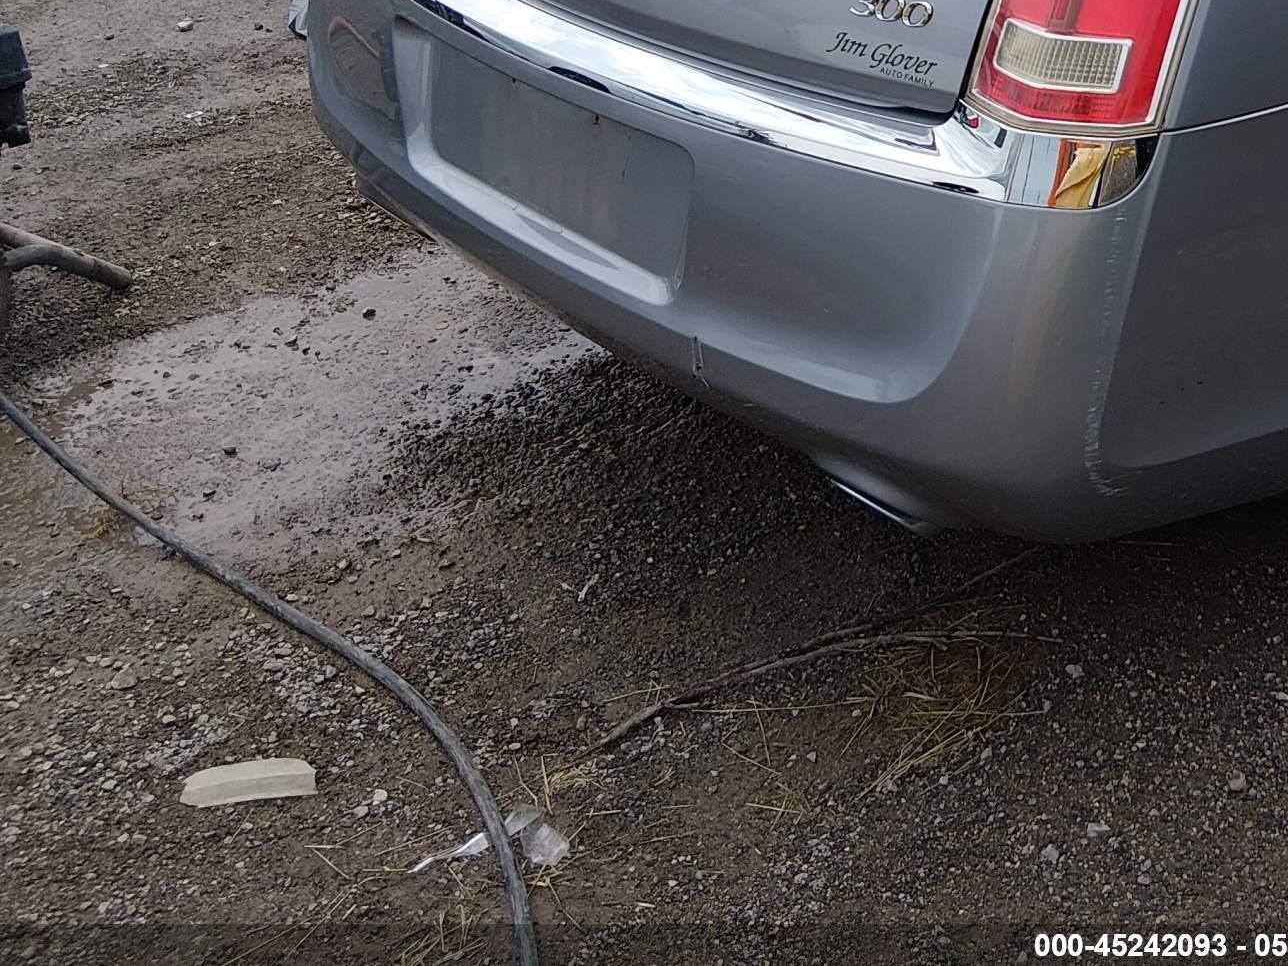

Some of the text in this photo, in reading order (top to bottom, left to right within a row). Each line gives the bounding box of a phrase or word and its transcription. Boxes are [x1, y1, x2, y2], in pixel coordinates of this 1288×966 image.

[825, 32, 938, 75] Jim Glover
[879, 67, 935, 88] AUTO FAMILY
